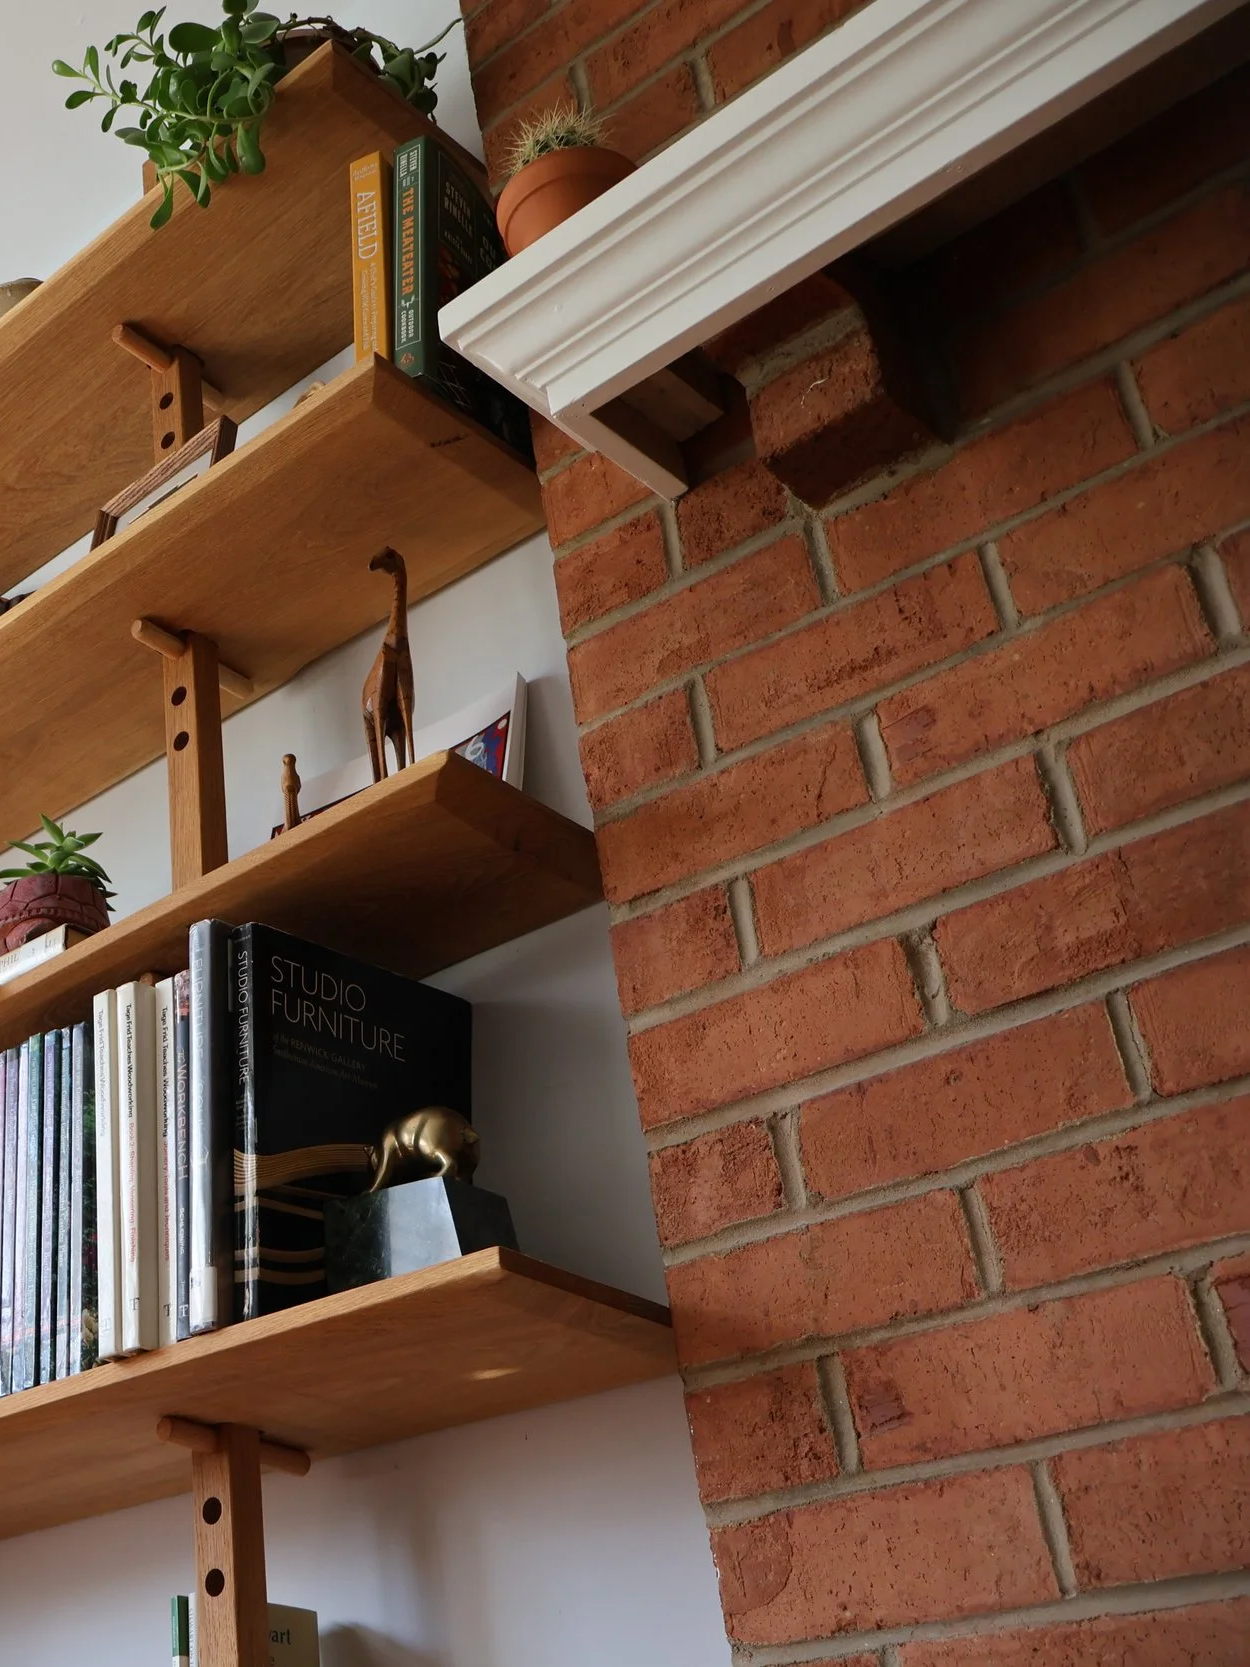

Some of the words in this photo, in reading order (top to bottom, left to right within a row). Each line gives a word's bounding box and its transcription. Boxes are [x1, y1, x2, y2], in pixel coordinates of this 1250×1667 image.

[400, 153, 408, 178] RINELLA
[409, 149, 418, 172] STEVEN
[356, 191, 378, 260] AFIELD
[402, 187, 414, 215] THE
[402, 216, 414, 295] MEATEATER
[237, 950, 249, 1003] STUDIO
[271, 955, 366, 1012] STUDIO
[238, 1006, 250, 1085] FURNITURE
[271, 989, 406, 1062] FURNITURE
[290, 1037, 329, 1060] RENWICK
[331, 1052, 367, 1074] GALLERY
[177, 1063, 187, 1180] WORKBENCH
